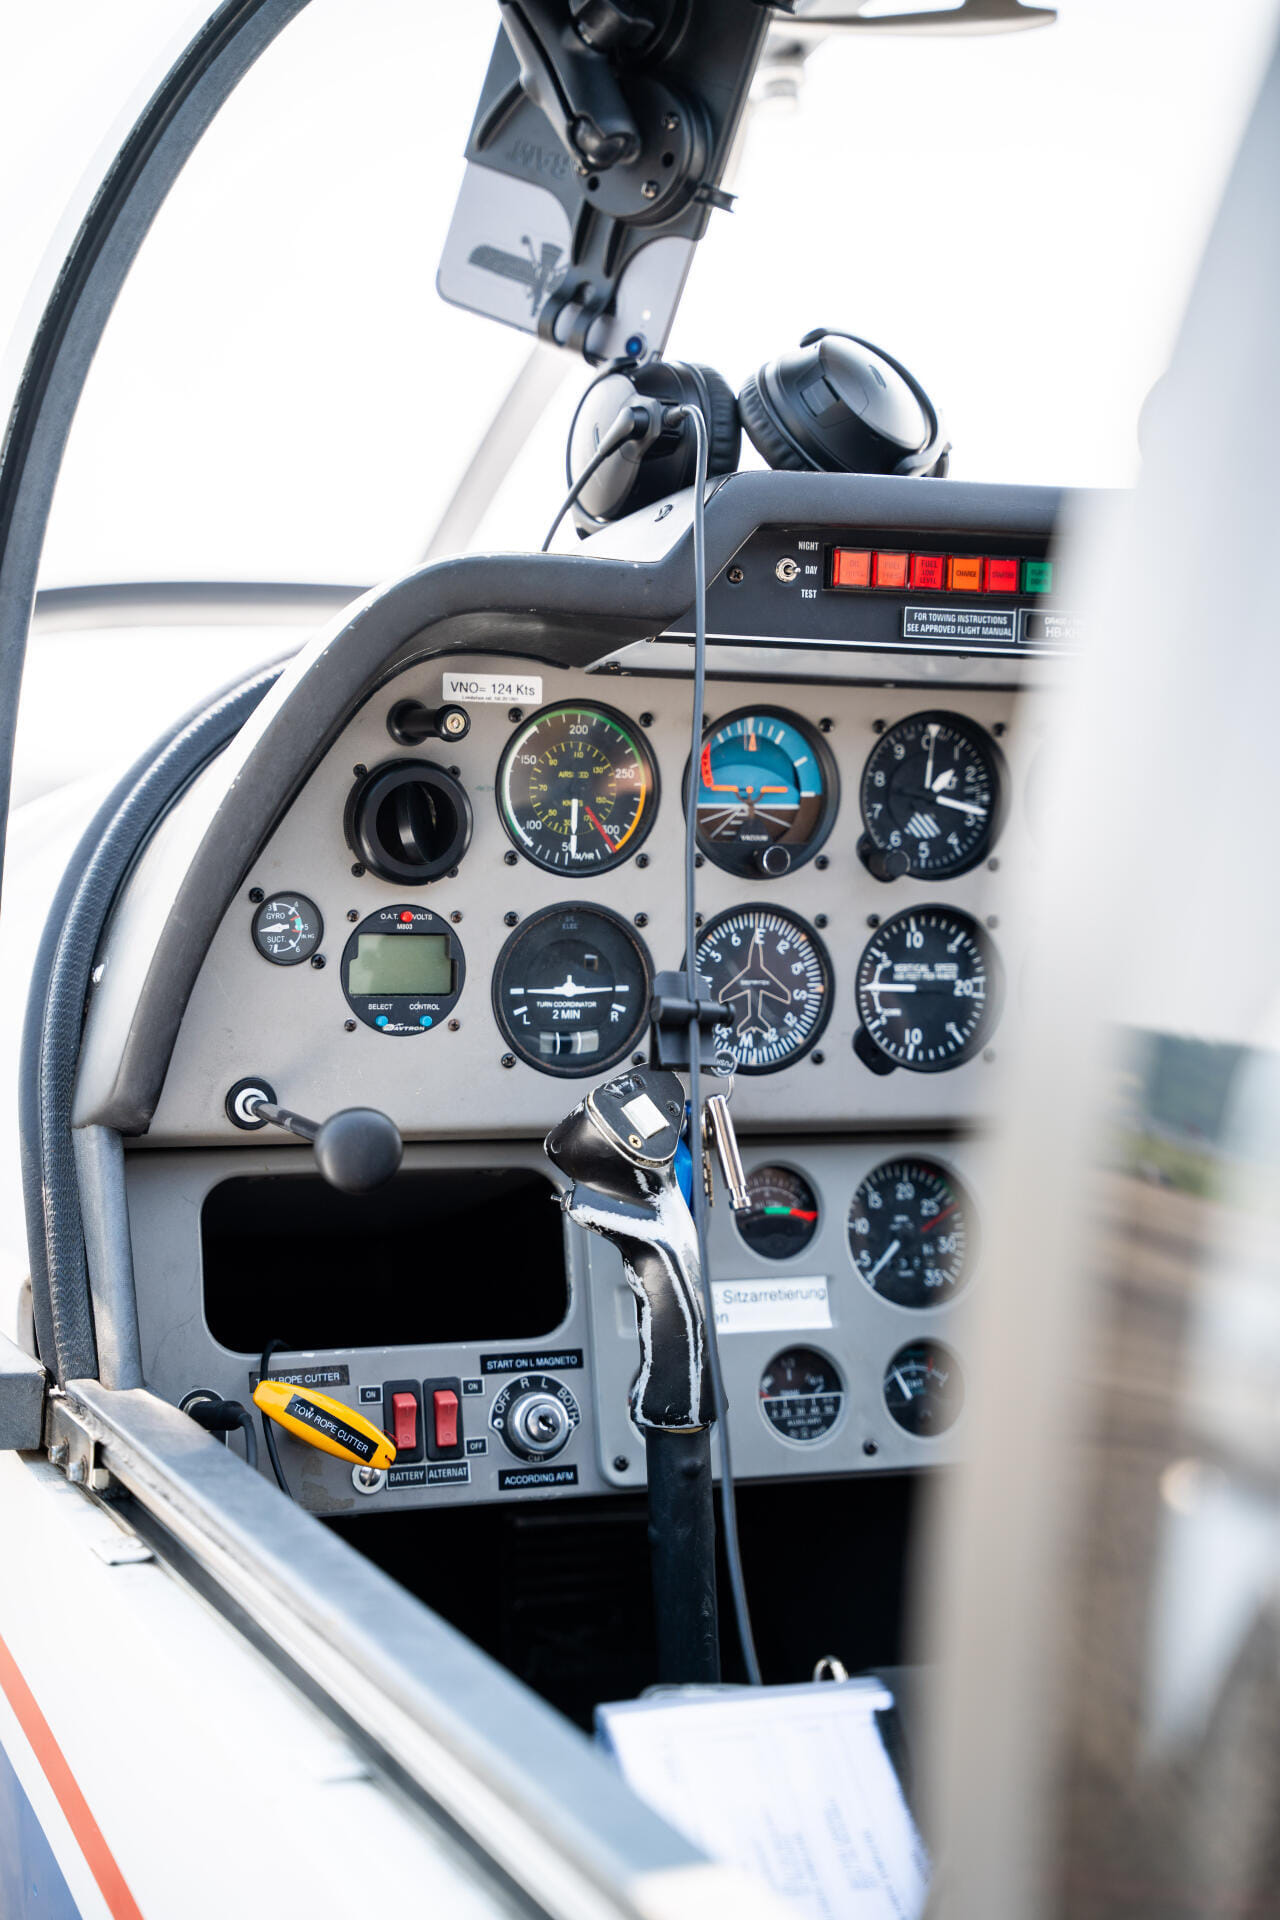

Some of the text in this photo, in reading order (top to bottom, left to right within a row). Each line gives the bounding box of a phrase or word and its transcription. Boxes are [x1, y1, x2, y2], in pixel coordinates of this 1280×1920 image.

[798, 541, 819, 551] NIGHT
[805, 566, 818, 575] DAY
[921, 560, 937, 568] FUEL
[919, 577, 936, 585] LEVEL
[801, 589, 817, 599] TEST
[914, 612, 1008, 625] FOR TOWING INSTRUCTIONS
[907, 623, 1012, 636] SEE APPROVED FLIGHT MANUAL
[492, 684, 512, 695] 124
[517, 684, 535, 696] Kts
[569, 724, 589, 735] 200
[894, 744, 905, 760] 9
[521, 755, 537, 765] 150
[615, 768, 635, 779] 250
[873, 770, 886, 787] 8
[964, 765, 977, 783] 2
[872, 803, 883, 819] 7
[526, 820, 542, 830] 100
[889, 830, 902, 847] 6
[918, 841, 930, 859] 5
[266, 912, 286, 920] GYRO
[304, 923, 309, 931] 5
[731, 933, 742, 947] 6
[755, 928, 765, 944] E
[906, 931, 924, 949] 10
[295, 945, 301, 953] 6
[953, 979, 974, 997] 20
[537, 1001, 552, 1009] TURN
[522, 1013, 531, 1025] L
[552, 1010, 581, 1020] 2 MIN
[610, 1012, 619, 1022] R
[739, 1033, 754, 1048] W
[904, 1027, 923, 1045] 10
[895, 1182, 915, 1200] 20
[868, 1191, 883, 1209] 15
[920, 1198, 940, 1217] 25
[855, 1217, 870, 1235] 10
[937, 1234, 957, 1254] 30
[860, 1249, 872, 1268] 5
[923, 1268, 944, 1287] 35
[722, 1286, 827, 1304] Sitzarretierung
[487, 1360, 514, 1370] START
[515, 1359, 529, 1369] ON
[535, 1355, 578, 1367] MAGNETO
[279, 1375, 303, 1384] ROPE
[304, 1372, 340, 1383] CUTTER
[520, 1377, 530, 1389] R
[541, 1378, 549, 1389] L
[467, 1383, 479, 1391] ON
[365, 1391, 376, 1399] ON
[494, 1389, 512, 1414] OFF
[556, 1387, 580, 1421] BOTH
[294, 1403, 369, 1454] TOW ROPE CUTTER
[469, 1443, 483, 1451] OFF
[389, 1470, 425, 1482] BATTERY
[428, 1467, 467, 1479] ALTERNAT
[504, 1471, 575, 1486] ACCORDING AFM
